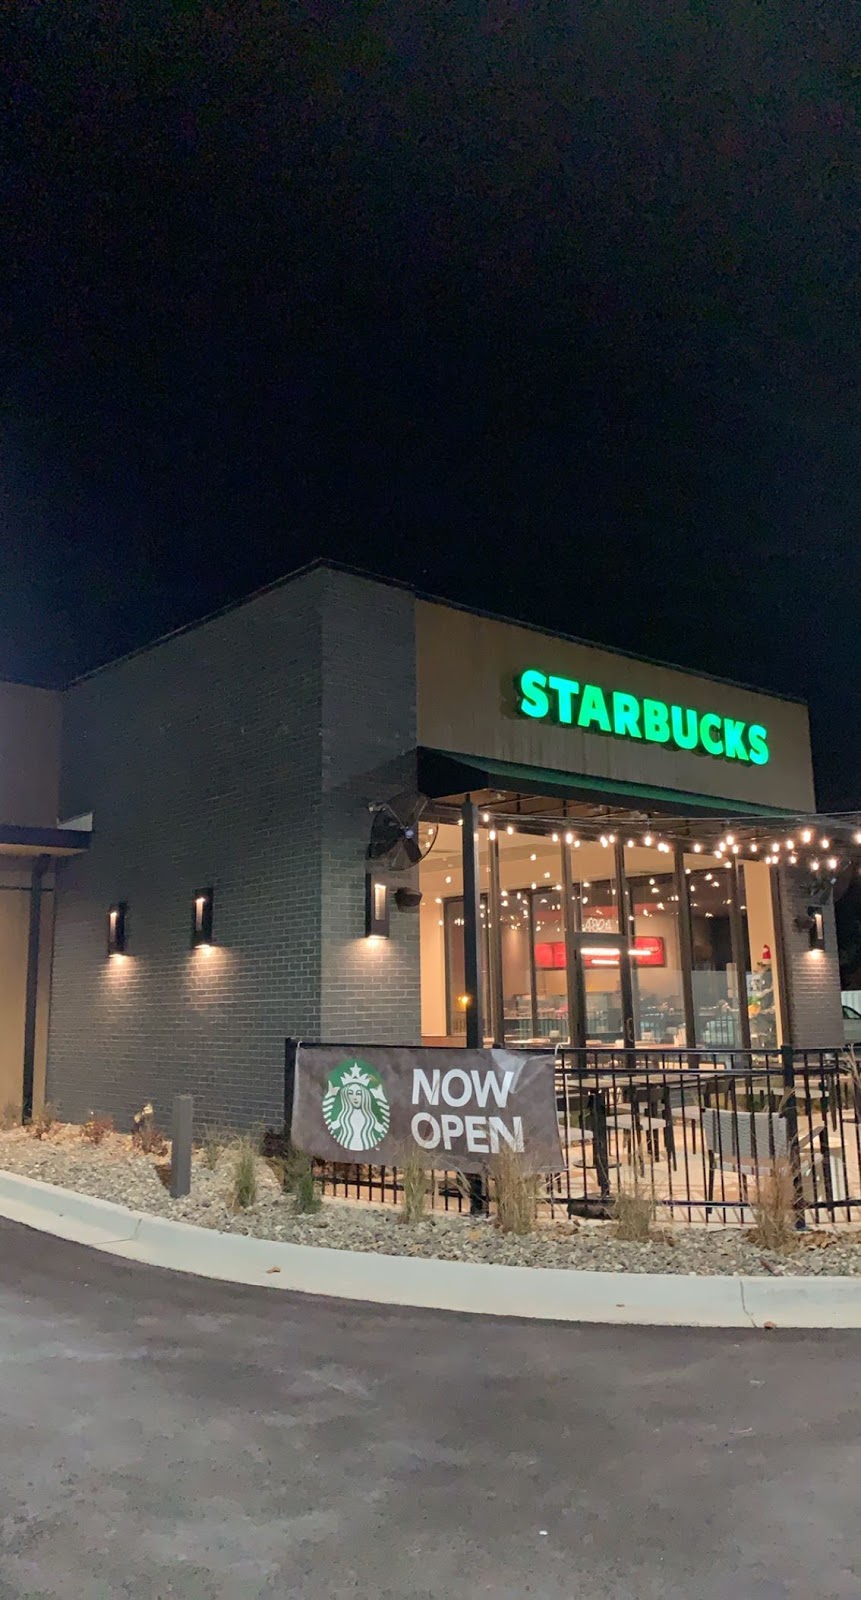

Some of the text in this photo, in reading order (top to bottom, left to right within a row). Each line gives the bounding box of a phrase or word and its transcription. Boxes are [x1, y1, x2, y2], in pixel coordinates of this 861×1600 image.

[520, 669, 769, 765] STARBUCKS
[411, 1069, 515, 1108] NOW
[410, 1112, 525, 1154] OPEN
